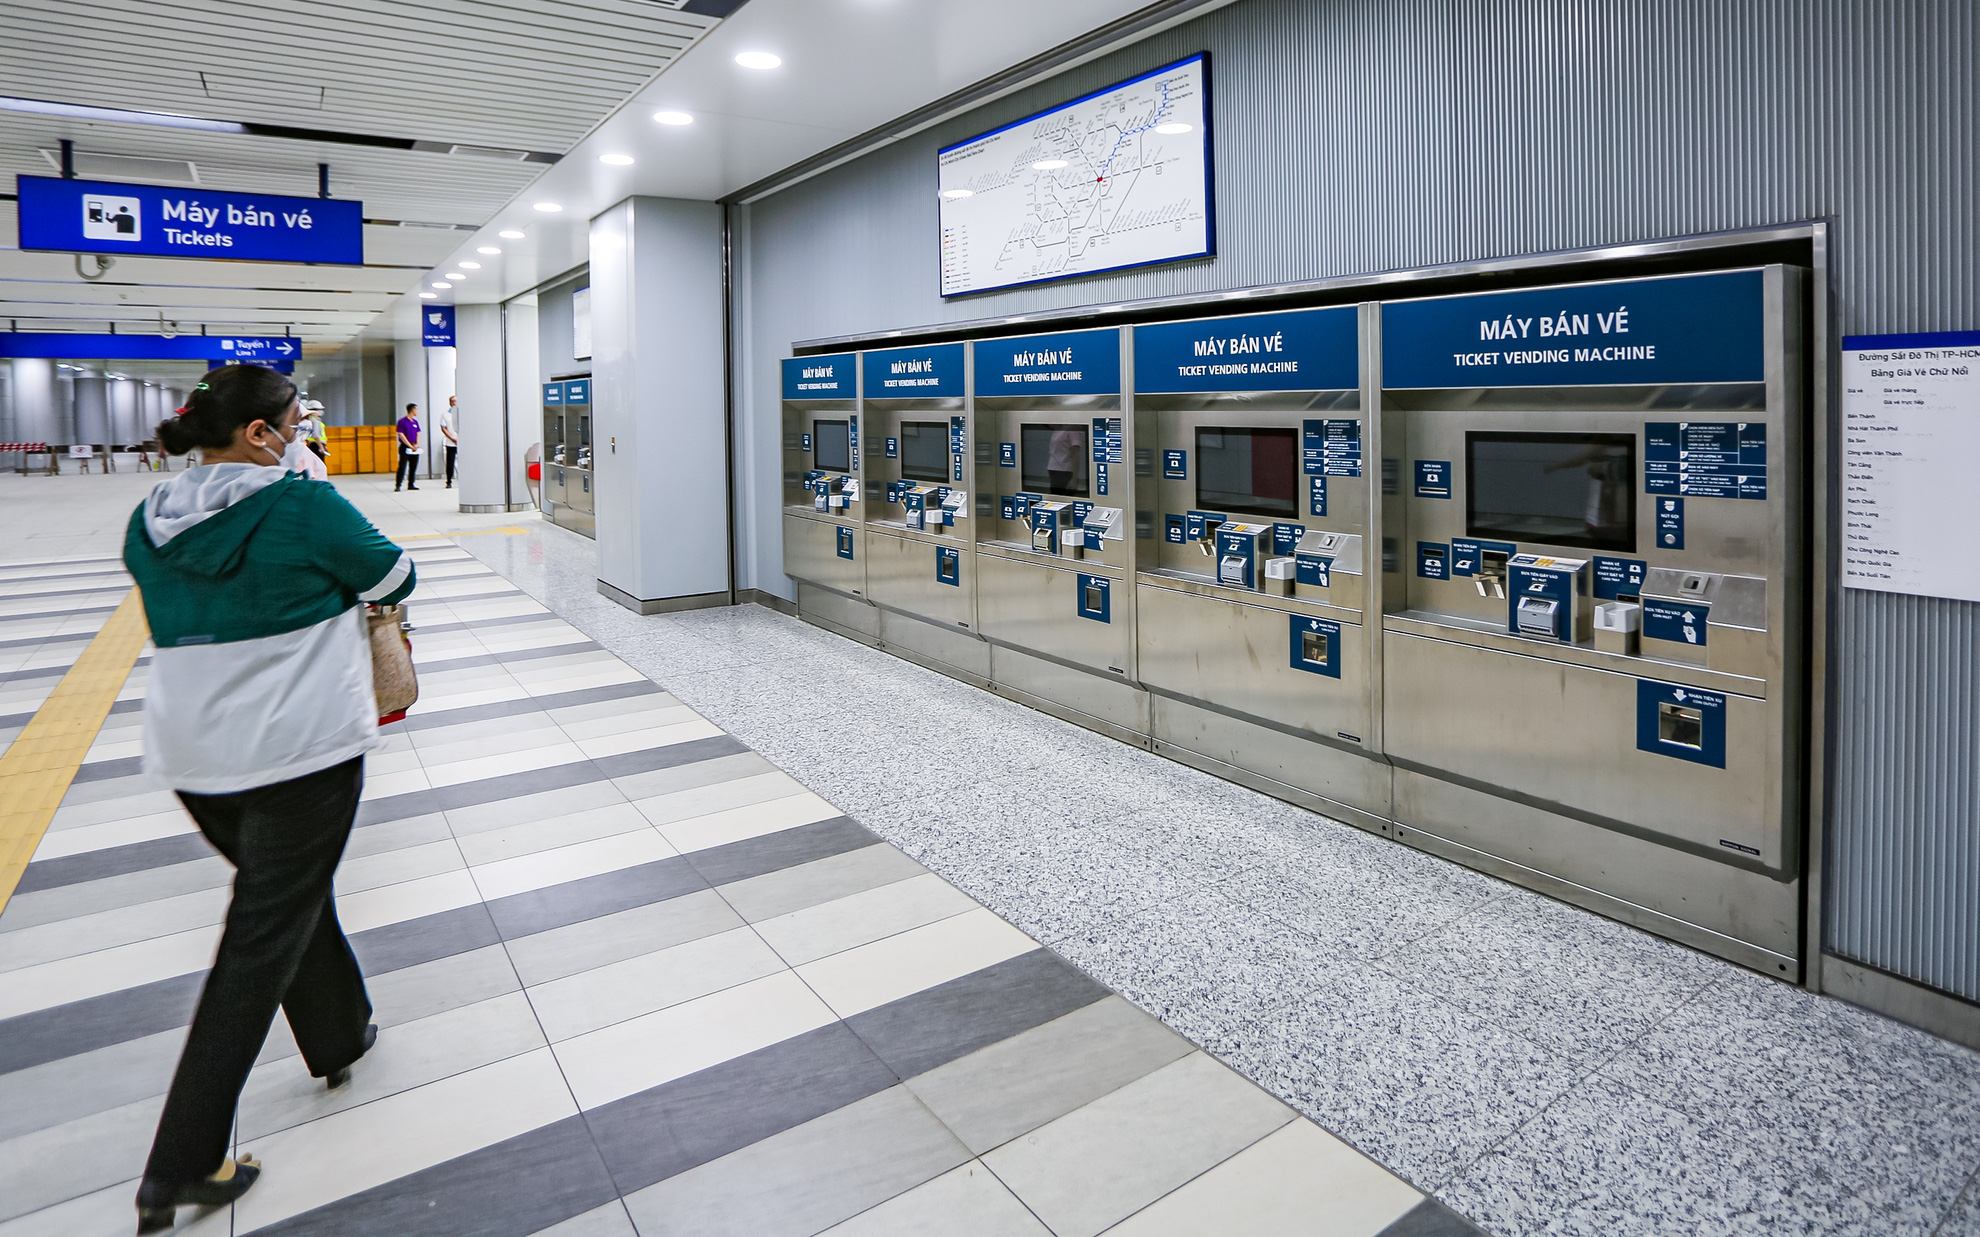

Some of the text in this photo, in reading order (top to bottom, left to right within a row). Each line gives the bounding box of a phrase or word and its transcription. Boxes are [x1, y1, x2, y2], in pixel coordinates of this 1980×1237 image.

[163, 199, 312, 230] Máy bán vé
[163, 228, 233, 247] Tickets
[1480, 307, 1629, 341] MÁY BÁN VÉ
[1194, 331, 1283, 356] MÁY BÁN VÉ
[1014, 347, 1072, 367] MÁY BÁN VÉ
[1454, 346, 1655, 366] TICKET VENDING MACHINE
[1859, 353, 1888, 362] Đường
[1891, 351, 1906, 360] Sắt
[1924, 351, 1939, 361] Thị
[802, 365, 833, 378] MÁY BÁN VÉ
[891, 358, 932, 374] MÁY BÁN VÉ
[1178, 361, 1298, 376] TICKET VENDING MACHINE
[1871, 369, 1894, 378] Bảng
[1929, 368, 1949, 376] Chữ
[884, 378, 938, 388] TICKET VENDING MACHINE
[1003, 371, 1082, 383] TICKET VENDING MACHINE
